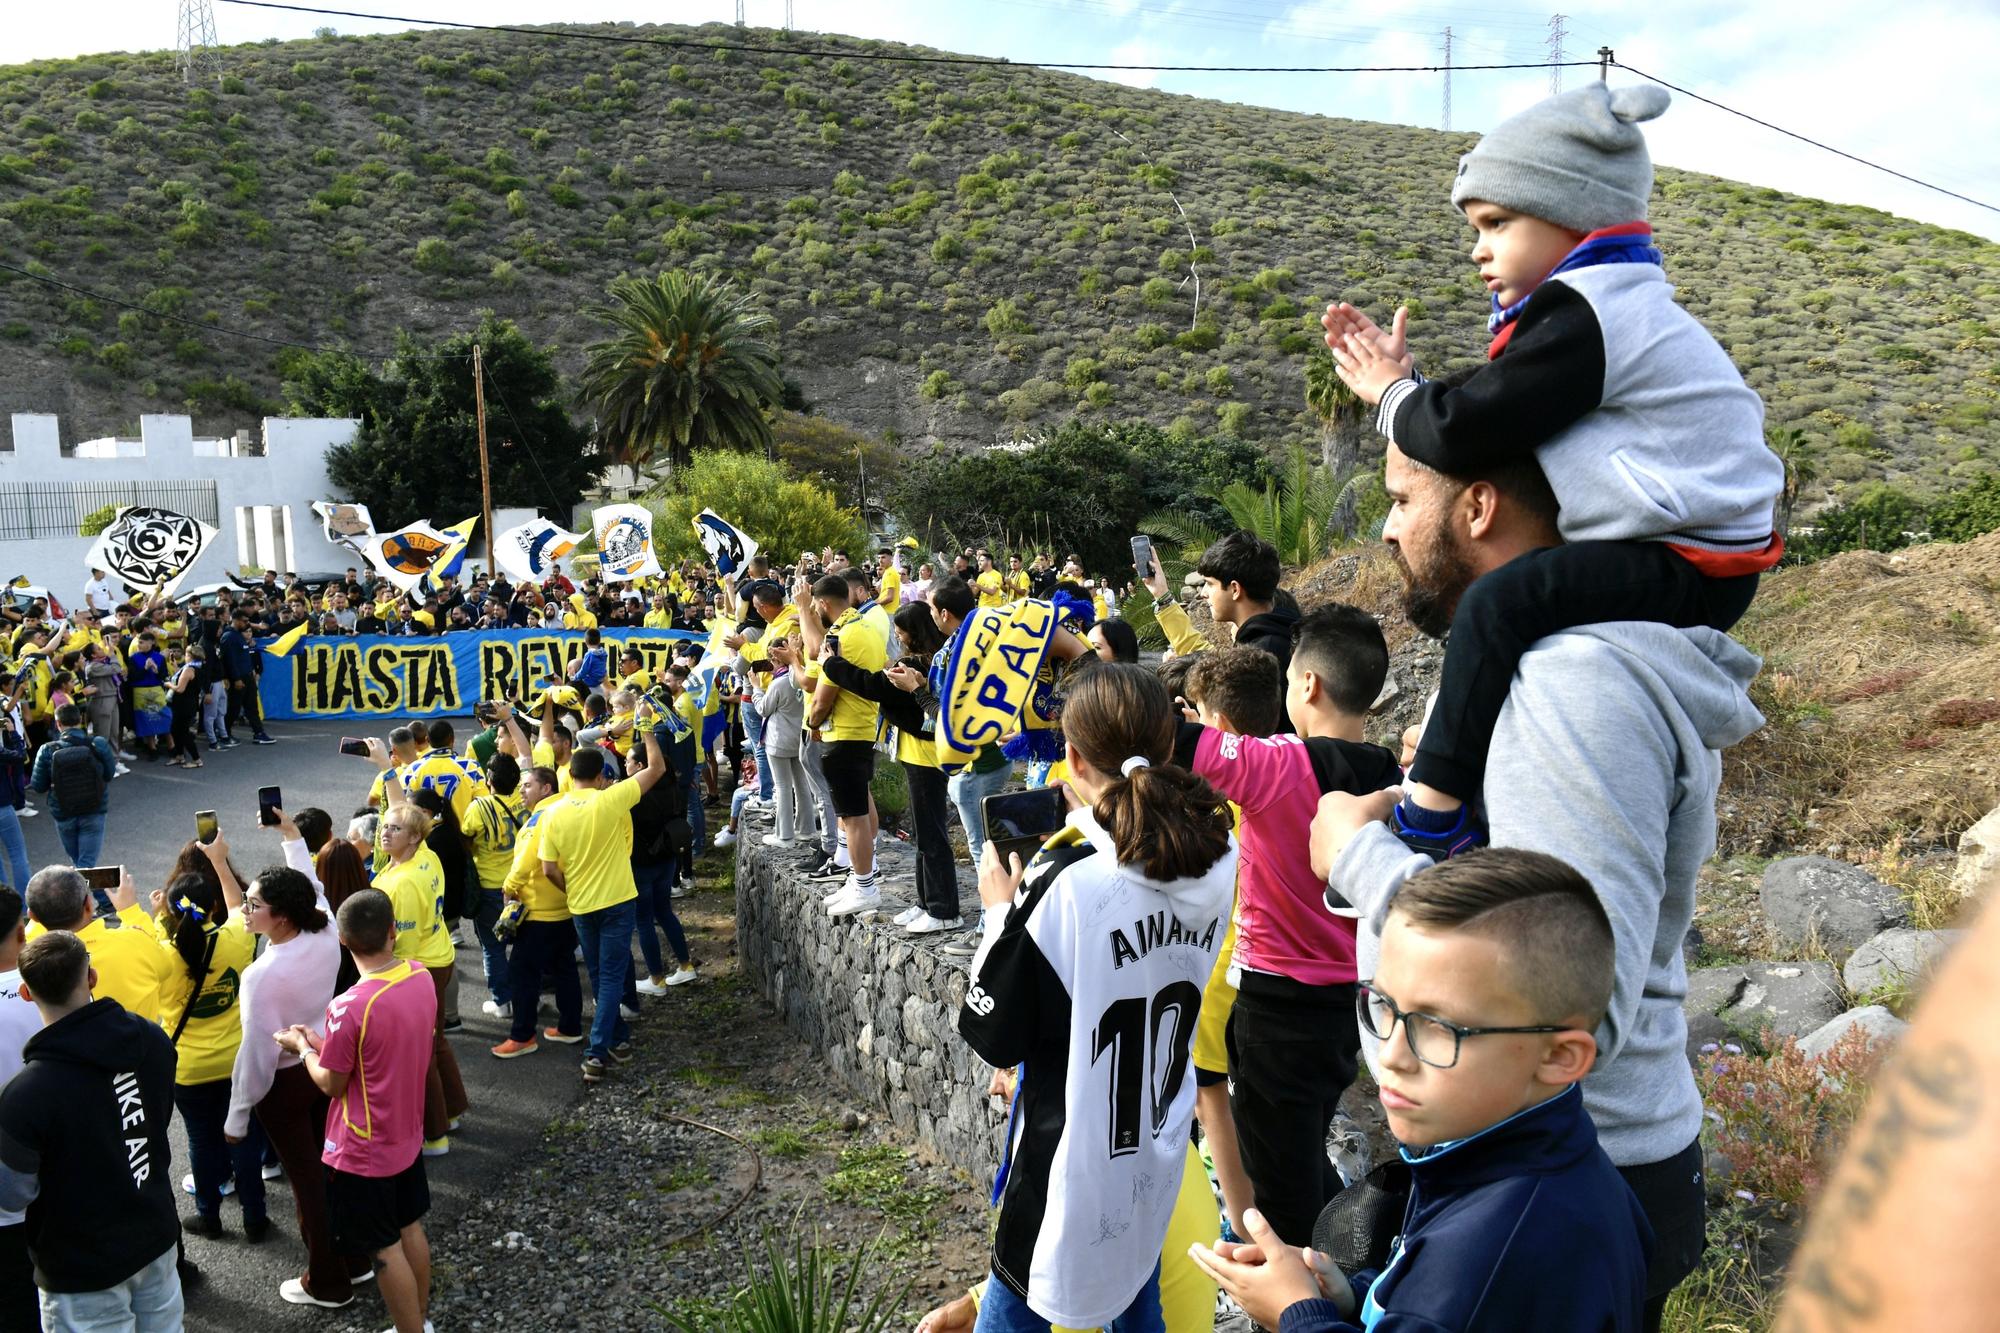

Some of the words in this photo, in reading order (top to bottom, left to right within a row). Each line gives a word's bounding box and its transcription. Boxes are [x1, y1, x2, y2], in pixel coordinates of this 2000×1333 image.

[296, 647, 456, 710] HASTA
[1091, 981, 1202, 1160] 10
[125, 1137, 150, 1190] AIR
